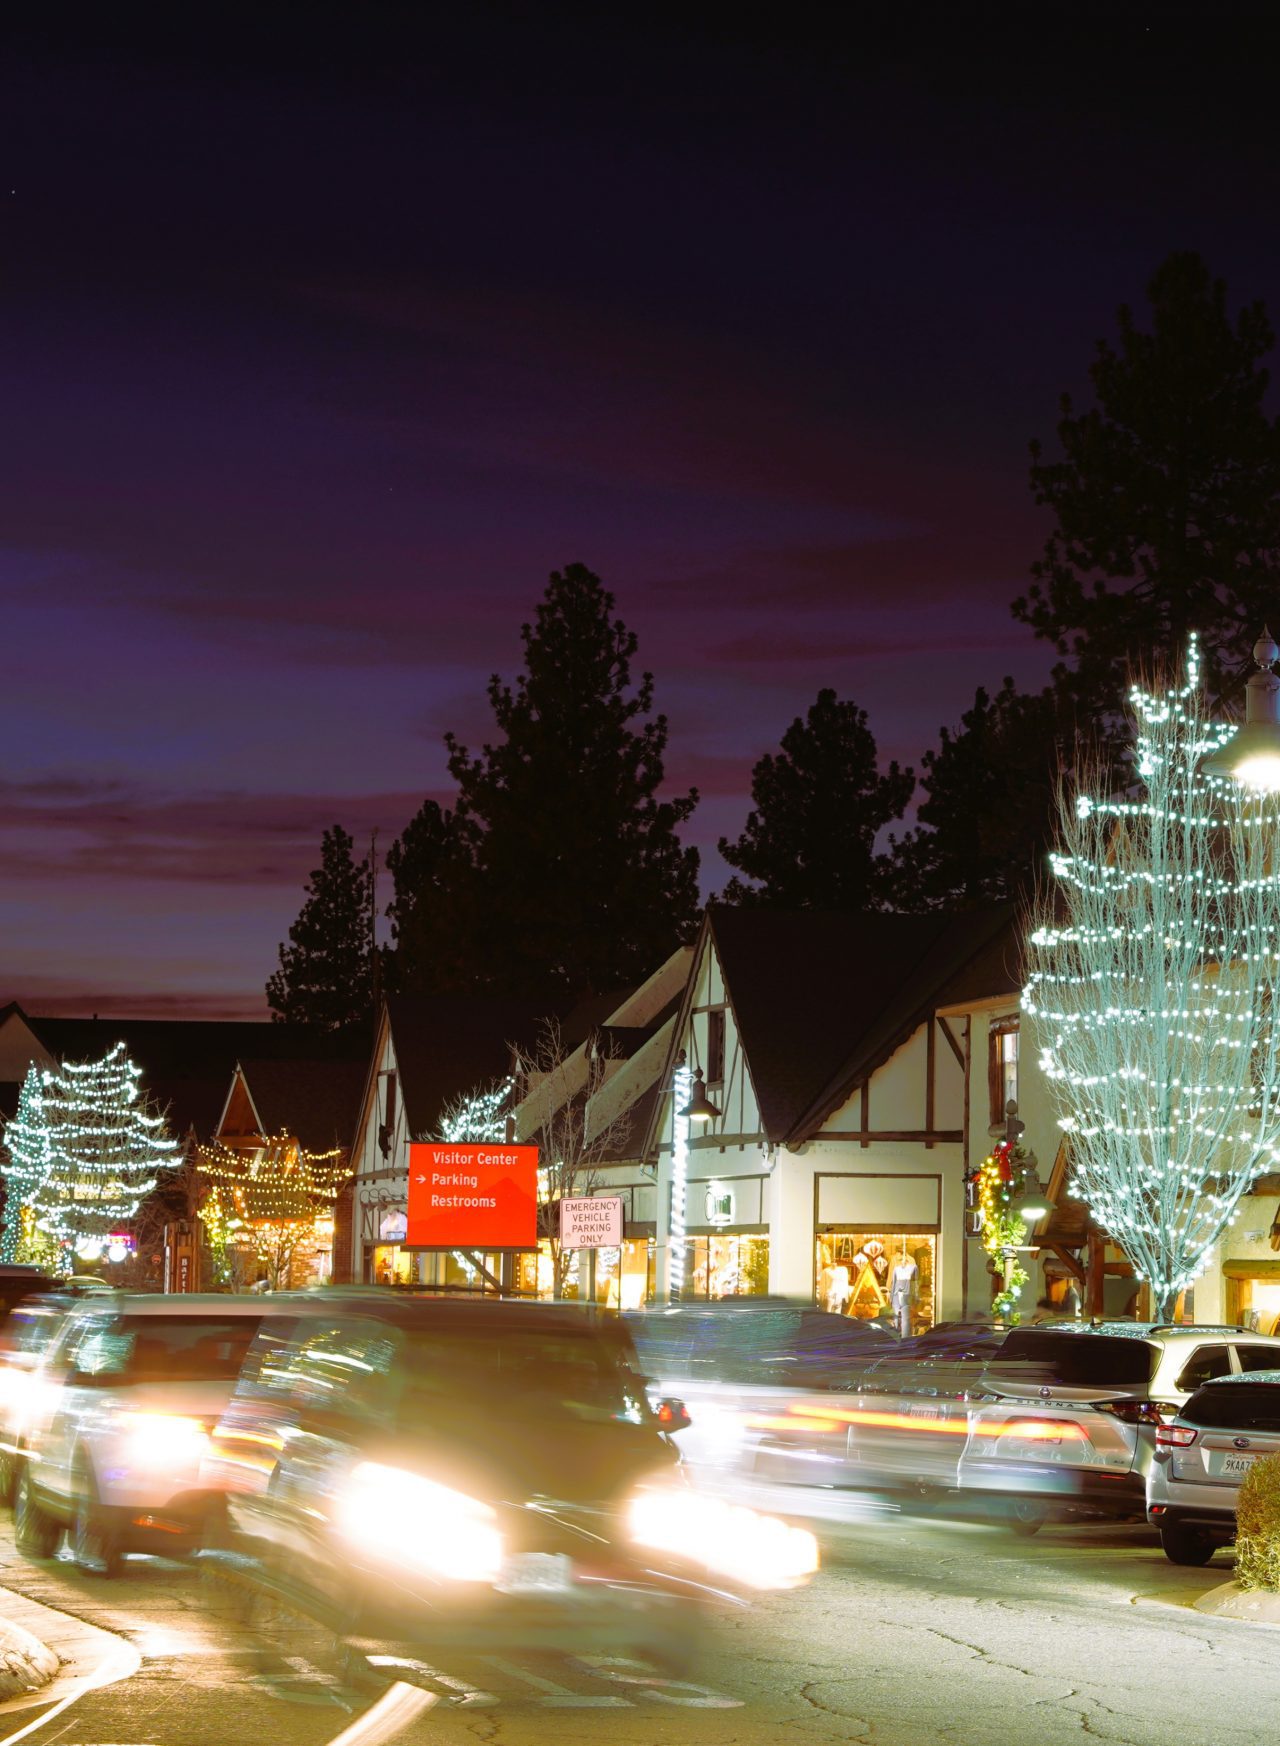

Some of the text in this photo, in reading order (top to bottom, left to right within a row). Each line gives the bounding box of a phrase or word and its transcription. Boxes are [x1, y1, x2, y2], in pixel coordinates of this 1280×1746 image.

[433, 1152, 518, 1165] Visitor Center
[432, 1173, 478, 1188] Parking
[431, 1195, 496, 1207] Restrooms
[565, 1201, 617, 1212] EMERGENCY
[572, 1212, 610, 1222] VEHICLE
[572, 1223, 611, 1232] PARKING
[580, 1234, 603, 1243] ONLY
[1017, 1399, 1074, 1408] SIENNA
[1226, 1460, 1251, 1471] 9KAA7
